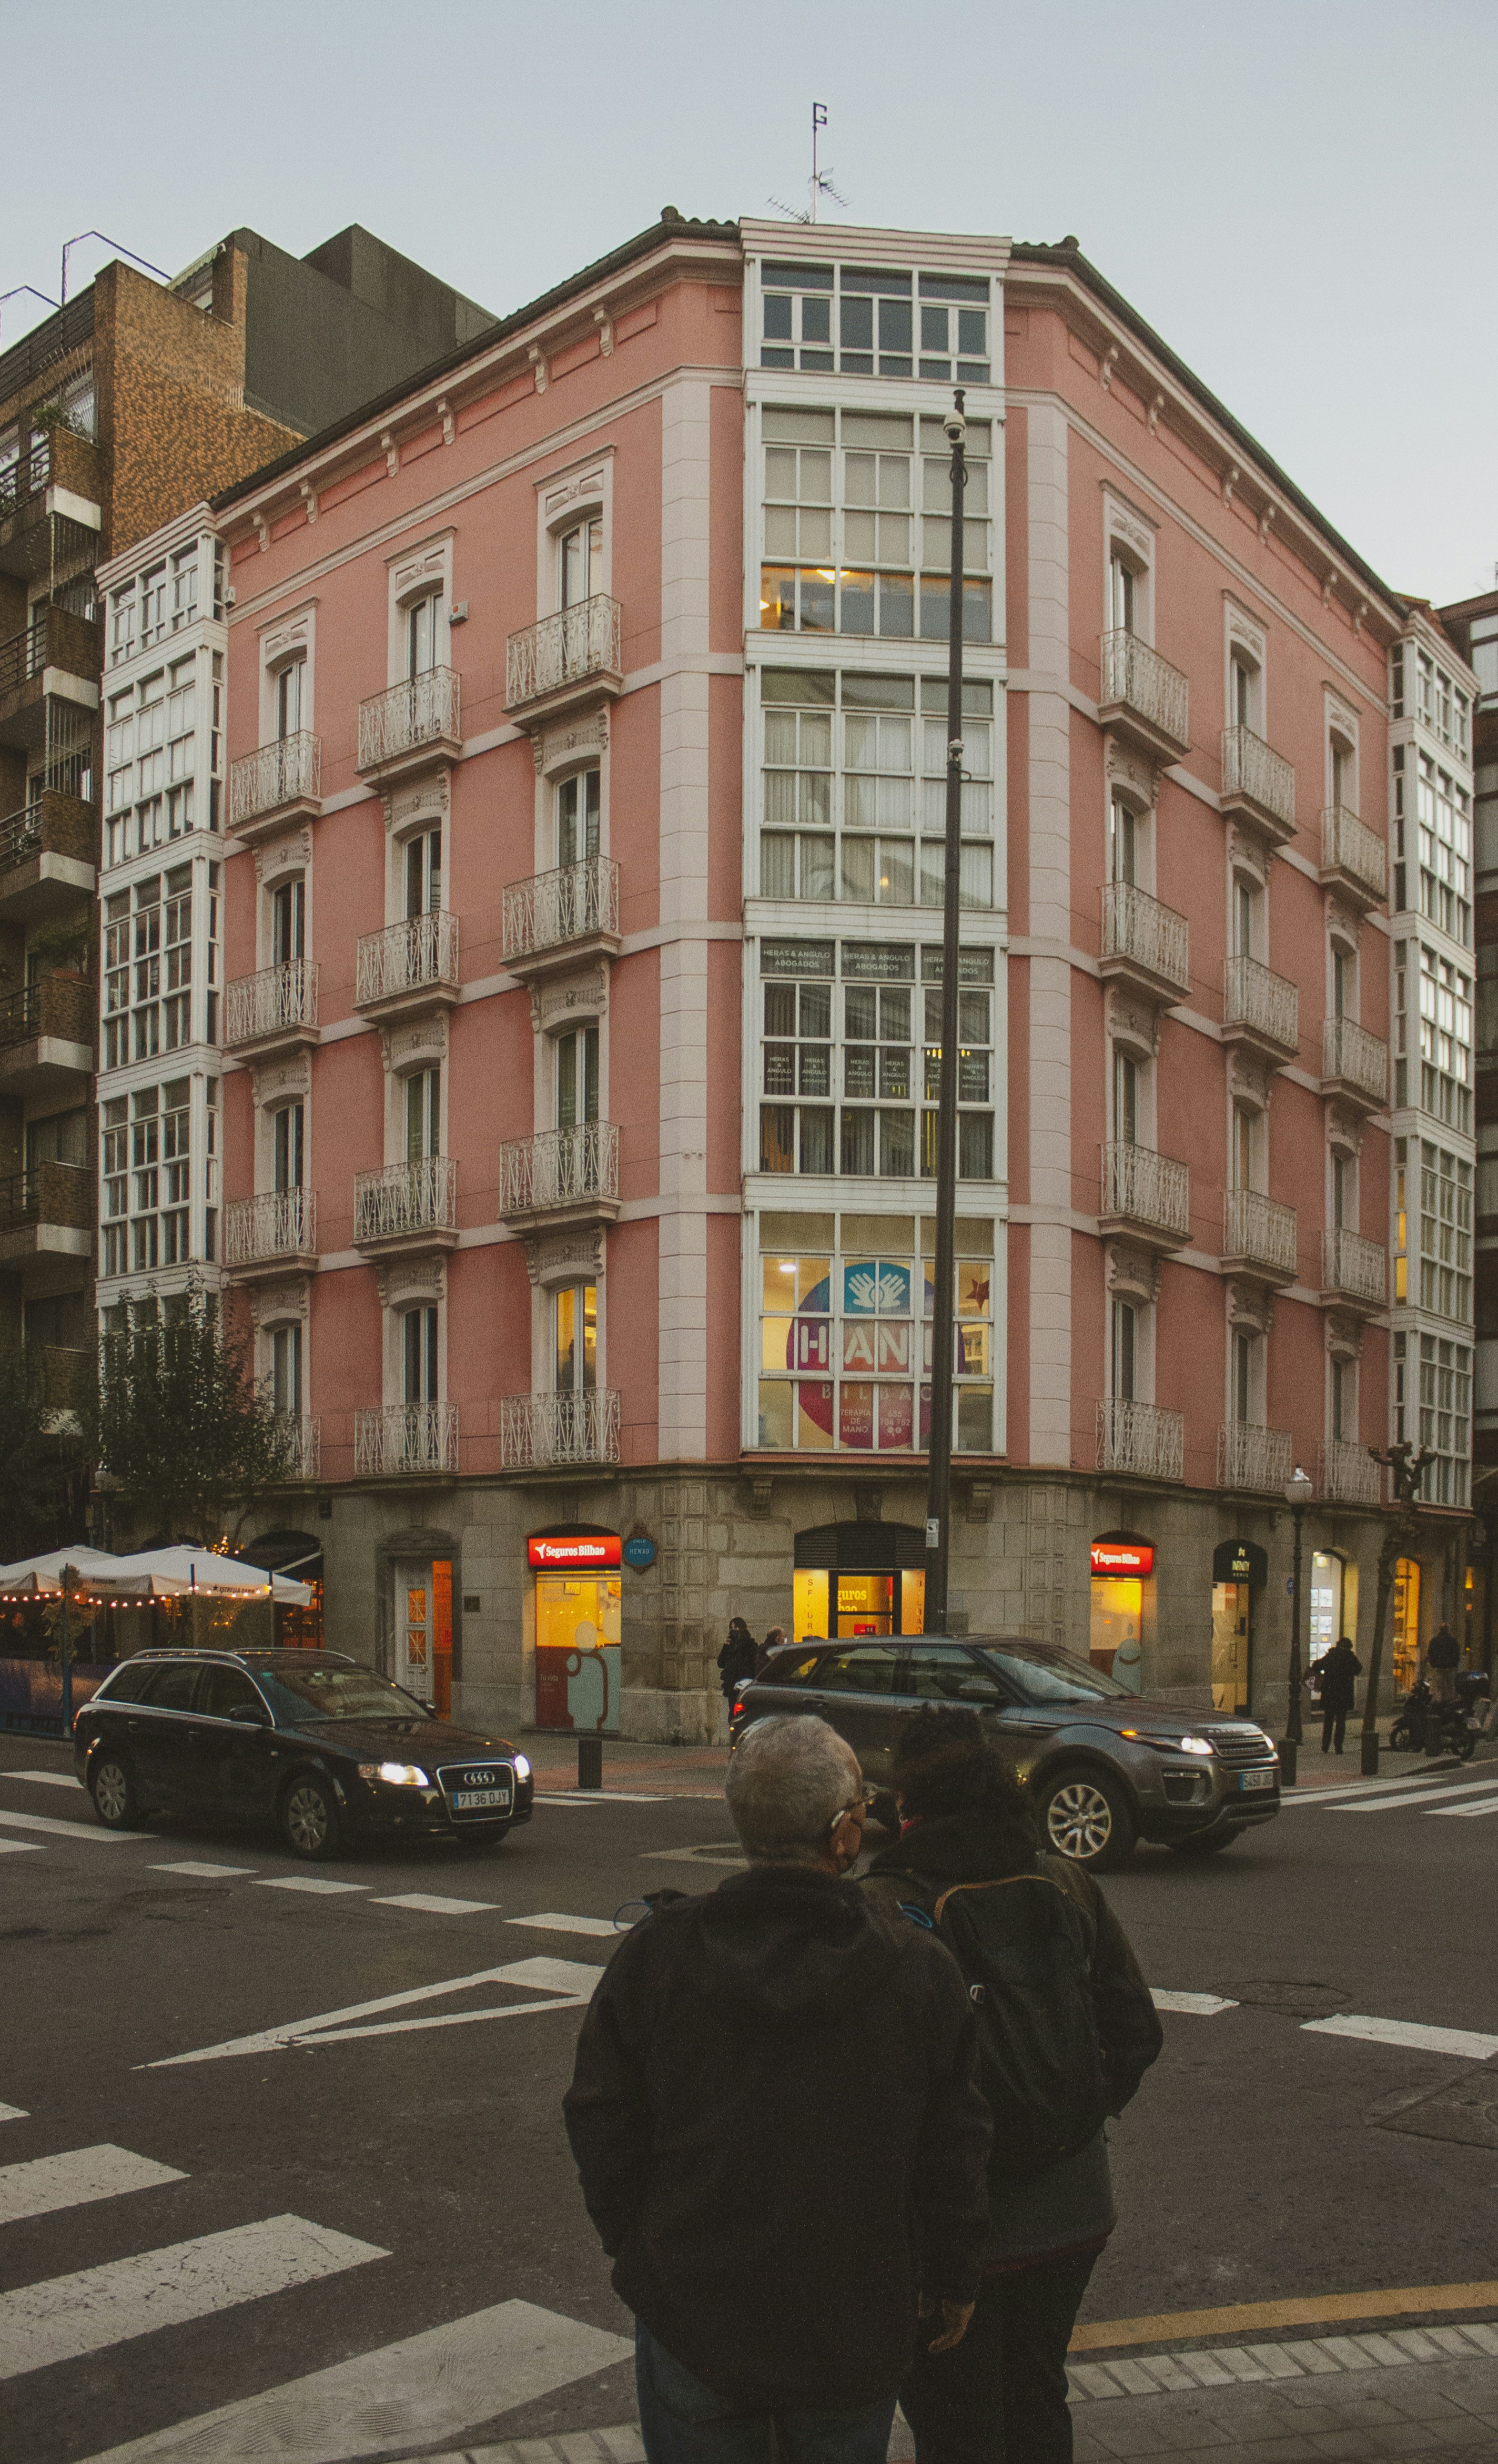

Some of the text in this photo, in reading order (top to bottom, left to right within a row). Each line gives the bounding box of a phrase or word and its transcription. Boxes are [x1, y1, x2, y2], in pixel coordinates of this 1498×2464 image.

[855, 962, 900, 971] ABOGADOS
[546, 1544, 605, 1558] Seguros Bilbao
[1099, 1552, 1140, 1565] Seguros Bilbao
[460, 1791, 507, 1806] 7136 DJY
